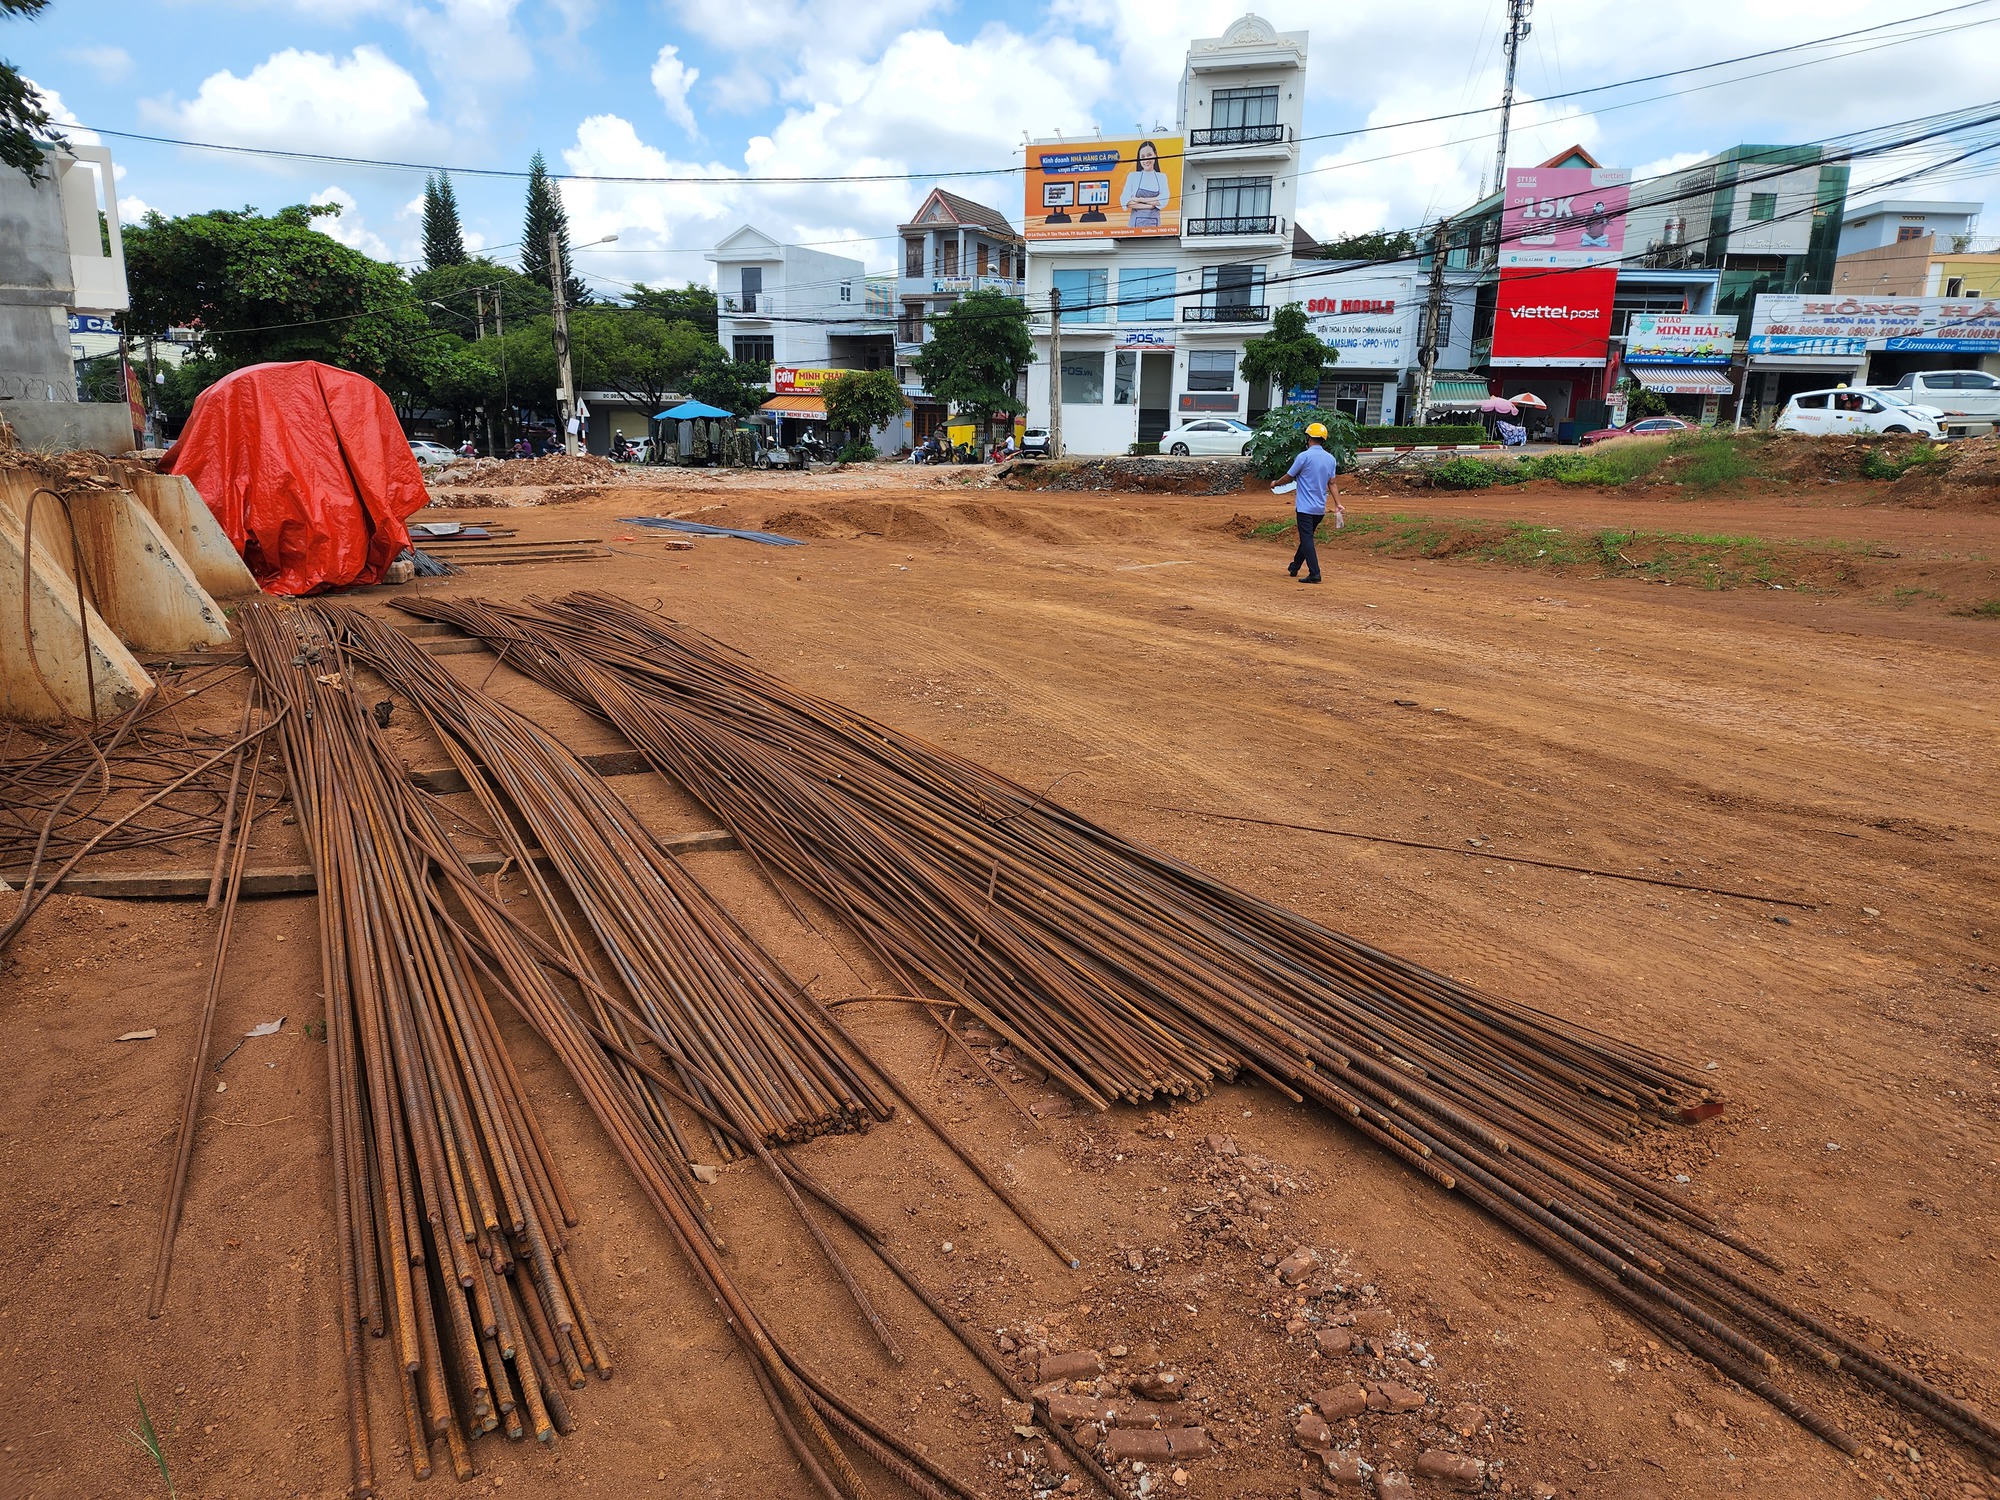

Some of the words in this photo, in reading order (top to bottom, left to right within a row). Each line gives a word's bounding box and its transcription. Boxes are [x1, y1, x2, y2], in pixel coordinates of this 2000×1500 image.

[1524, 197, 1576, 218] 15K
[1308, 297, 1336, 313] SƠN
[1340, 299, 1395, 314] MOBILE
[1802, 298, 1922, 316] HỒNG
[1510, 305, 1569, 318] viettel
[1570, 308, 1600, 320] post
[1348, 325, 1361, 334] ĐỘNG
[1656, 326, 1691, 335] MINH
[1694, 323, 1719, 336] HẢI
[1327, 339, 1358, 348] SAMSUNG
[1362, 339, 1379, 348] OPPO
[1383, 339, 1399, 348] VIVO
[1888, 338, 1957, 350] Limousine
[776, 370, 794, 383] CƠM
[798, 372, 820, 380] MINH
[1061, 367, 1092, 376] POS.VN
[1645, 384, 1673, 393] CHÁO
